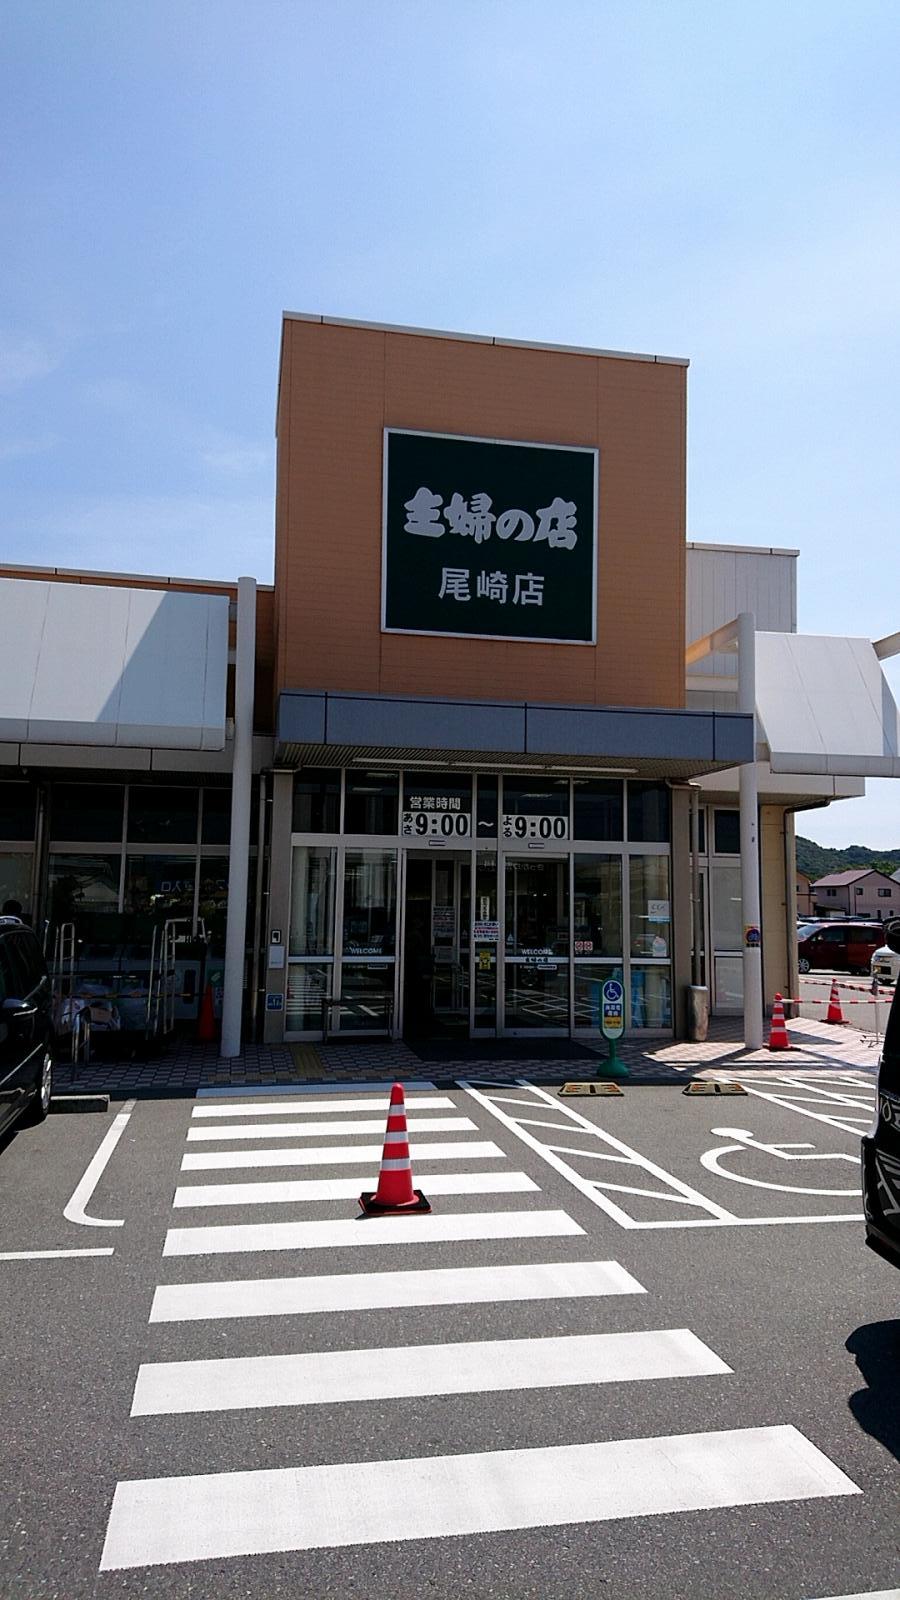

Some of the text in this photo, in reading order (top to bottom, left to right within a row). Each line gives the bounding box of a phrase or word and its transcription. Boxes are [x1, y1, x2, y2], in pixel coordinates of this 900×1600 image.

[404, 487, 577, 550] 主婦の店
[438, 567, 545, 606] 尾崎店
[409, 796, 461, 811] 営業時間
[403, 813, 413, 835] あさ
[415, 813, 468, 836] 9:00
[503, 816, 513, 838] よる
[514, 816, 566, 839] 9:00
